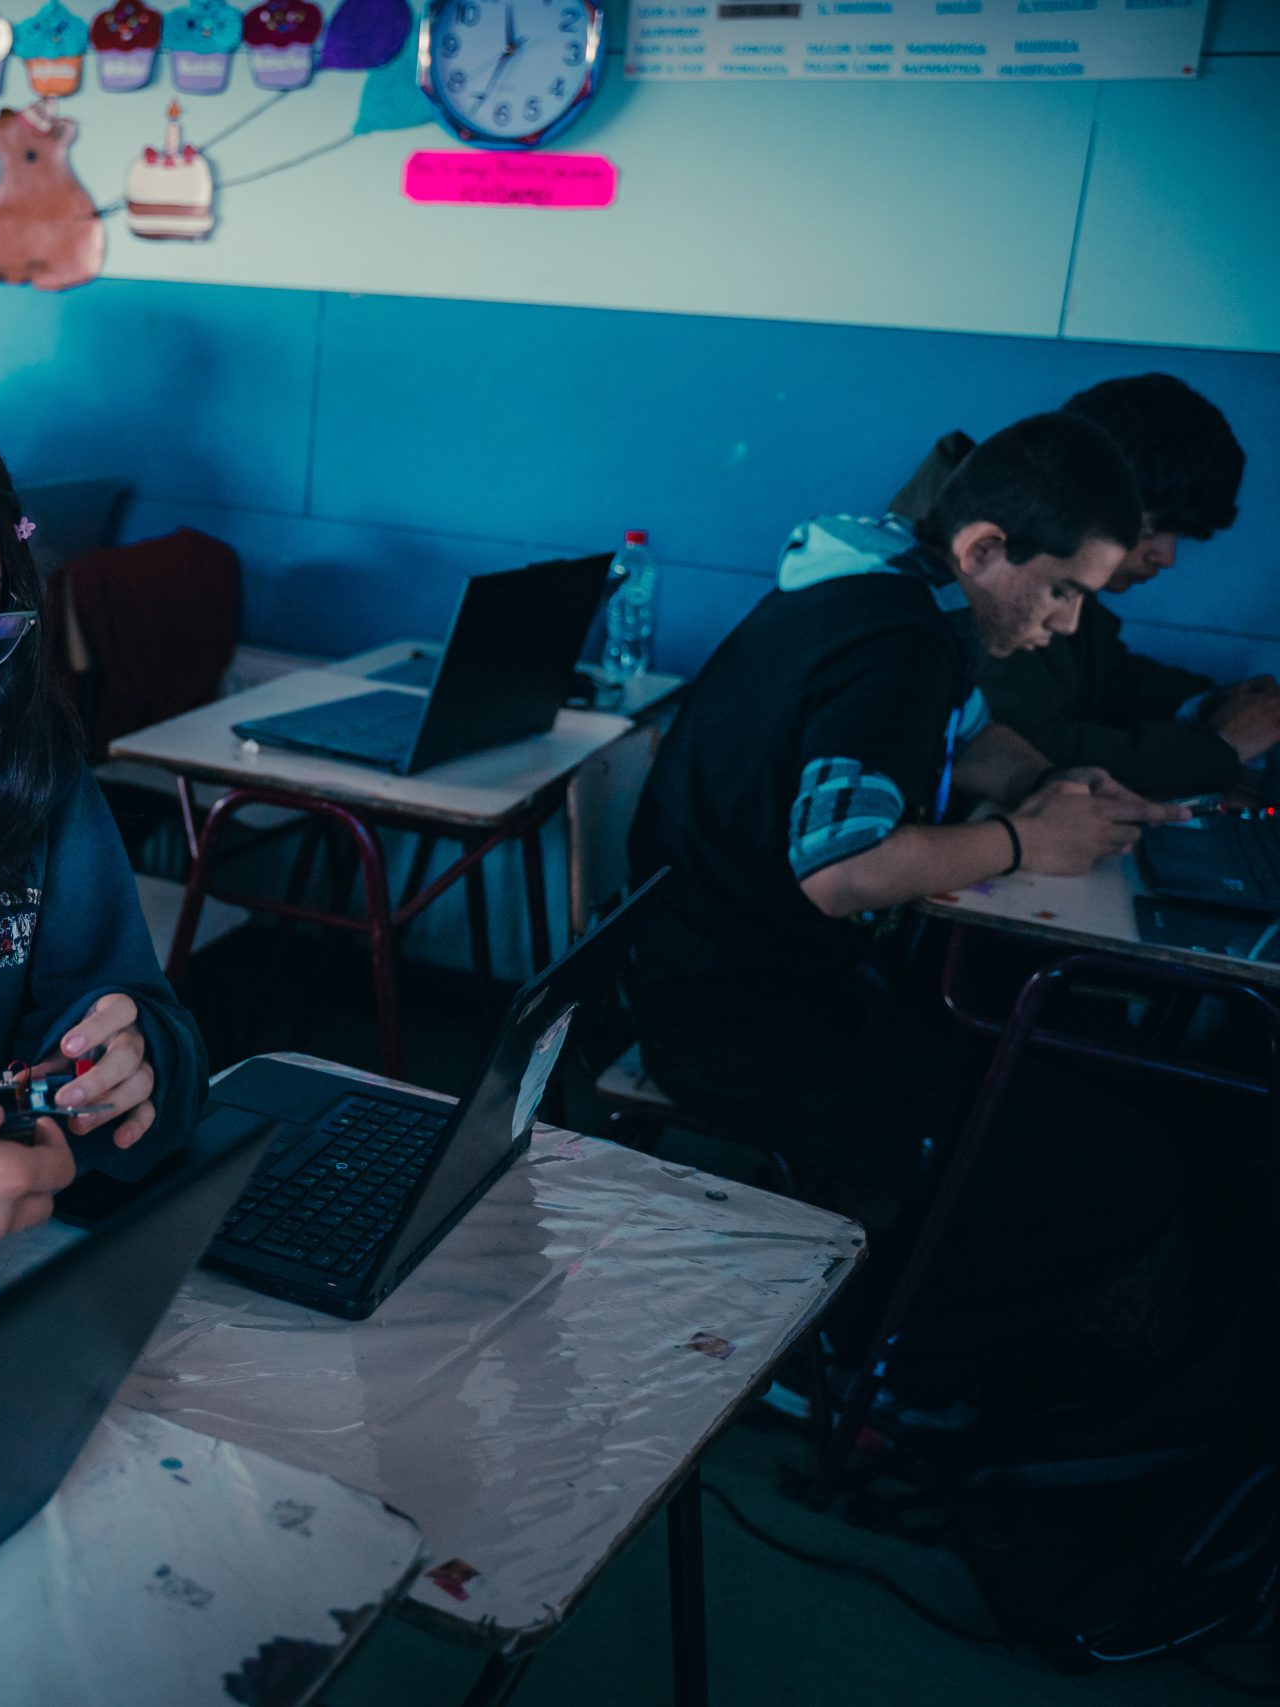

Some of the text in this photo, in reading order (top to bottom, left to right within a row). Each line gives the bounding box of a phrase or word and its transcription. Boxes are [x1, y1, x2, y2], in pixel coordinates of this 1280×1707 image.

[456, 1, 480, 27] 10
[559, 6, 579, 33] 2
[441, 32, 461, 59] 9
[562, 40, 581, 67] 3
[447, 67, 467, 94] 8
[548, 75, 566, 100] 4
[492, 101, 513, 127] 6
[521, 95, 542, 122] 5
